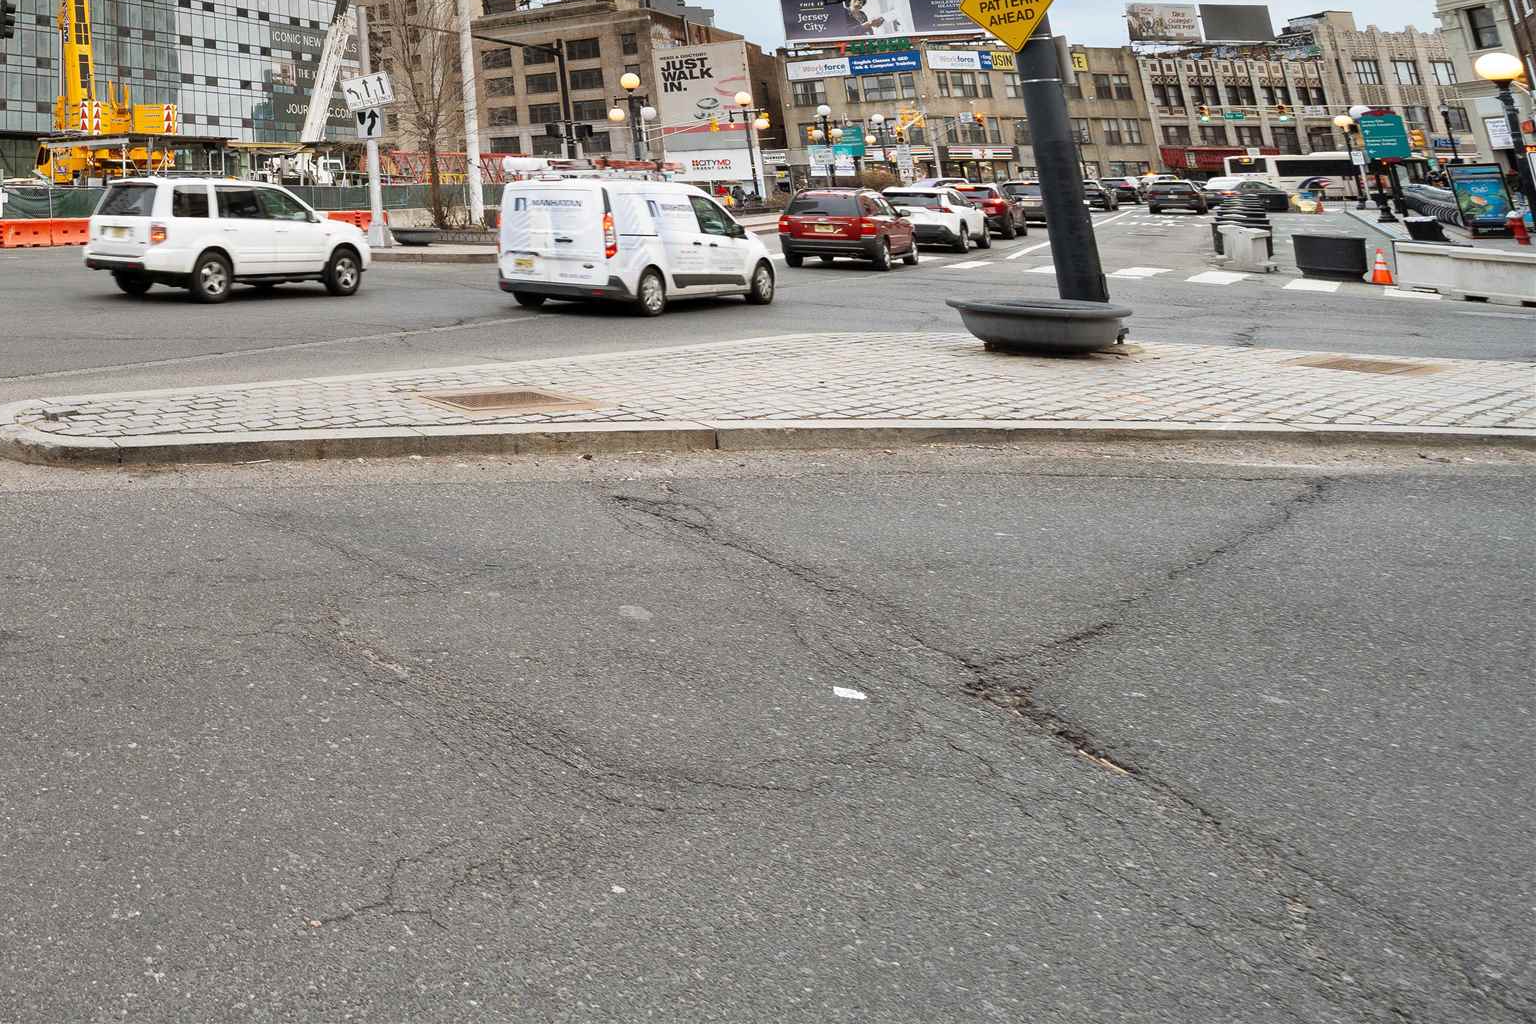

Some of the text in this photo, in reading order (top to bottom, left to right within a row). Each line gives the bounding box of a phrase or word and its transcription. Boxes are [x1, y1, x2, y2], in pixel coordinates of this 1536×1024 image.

[797, 12, 829, 23] Jersey
[988, 8, 1036, 27] AHEAD
[803, 22, 827, 32] City.
[272, 31, 321, 48] ICONIC NEW
[661, 57, 709, 72] JUST
[661, 67, 714, 82] WALK
[664, 81, 688, 92] IN.
